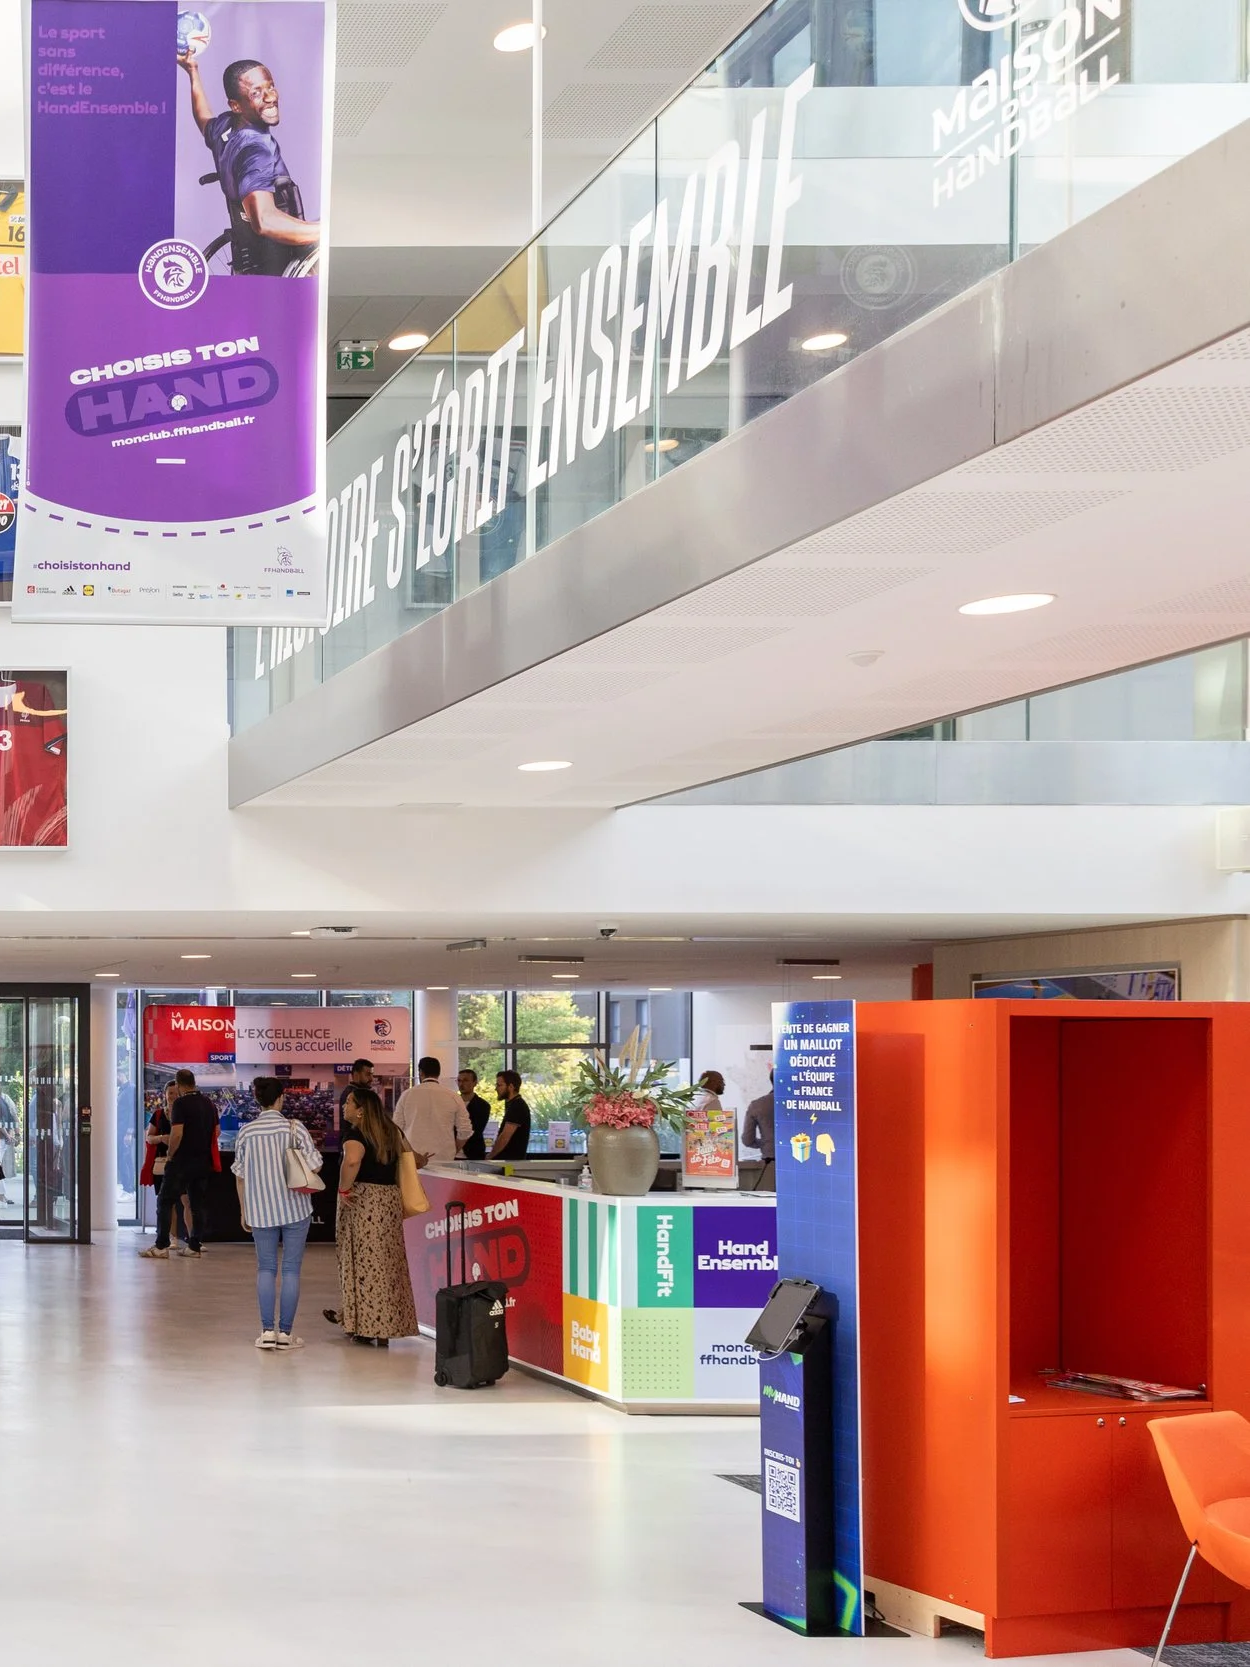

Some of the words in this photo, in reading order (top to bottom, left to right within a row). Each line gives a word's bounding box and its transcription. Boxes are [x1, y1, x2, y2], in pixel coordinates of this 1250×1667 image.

[38, 25, 57, 39] Le
[60, 27, 105, 42] sport
[38, 46, 76, 58] sans
[38, 63, 124, 79] différence,
[78, 82, 92, 96] le
[38, 101, 158, 115] HandEnsemble
[8, 226, 25, 242] 16
[527, 63, 816, 493] ENSEMBLE
[70, 349, 192, 385] CHOISIS
[196, 336, 259, 361] TON
[77, 364, 271, 431] HAND
[111, 415, 255, 448] monclub.ffhandball.fr
[171, 1018, 235, 1032] MAISON
[803, 1024, 814, 1034] DE
[816, 1022, 850, 1033] GAGNER
[237, 1028, 331, 1040] L'EXCELLENCE
[259, 1041, 292, 1052] vous
[295, 1038, 353, 1052] accueille
[783, 1039, 798, 1051] UN
[800, 1038, 843, 1051] MAILLOT
[790, 1054, 836, 1068] DÉDICACÉ
[799, 1070, 835, 1083] L'ÉQUIPE
[801, 1085, 833, 1096] FRANCE
[786, 1099, 797, 1110] DE
[798, 1100, 841, 1111] HANDBALL
[425, 1208, 483, 1240] CHOISIS
[484, 1199, 520, 1224] TON
[656, 1214, 674, 1298] HandFit
[718, 1240, 769, 1256] Hand
[698, 1255, 778, 1271] Ensembl
[571, 1320, 600, 1349] Baby
[571, 1337, 600, 1365] Hand
